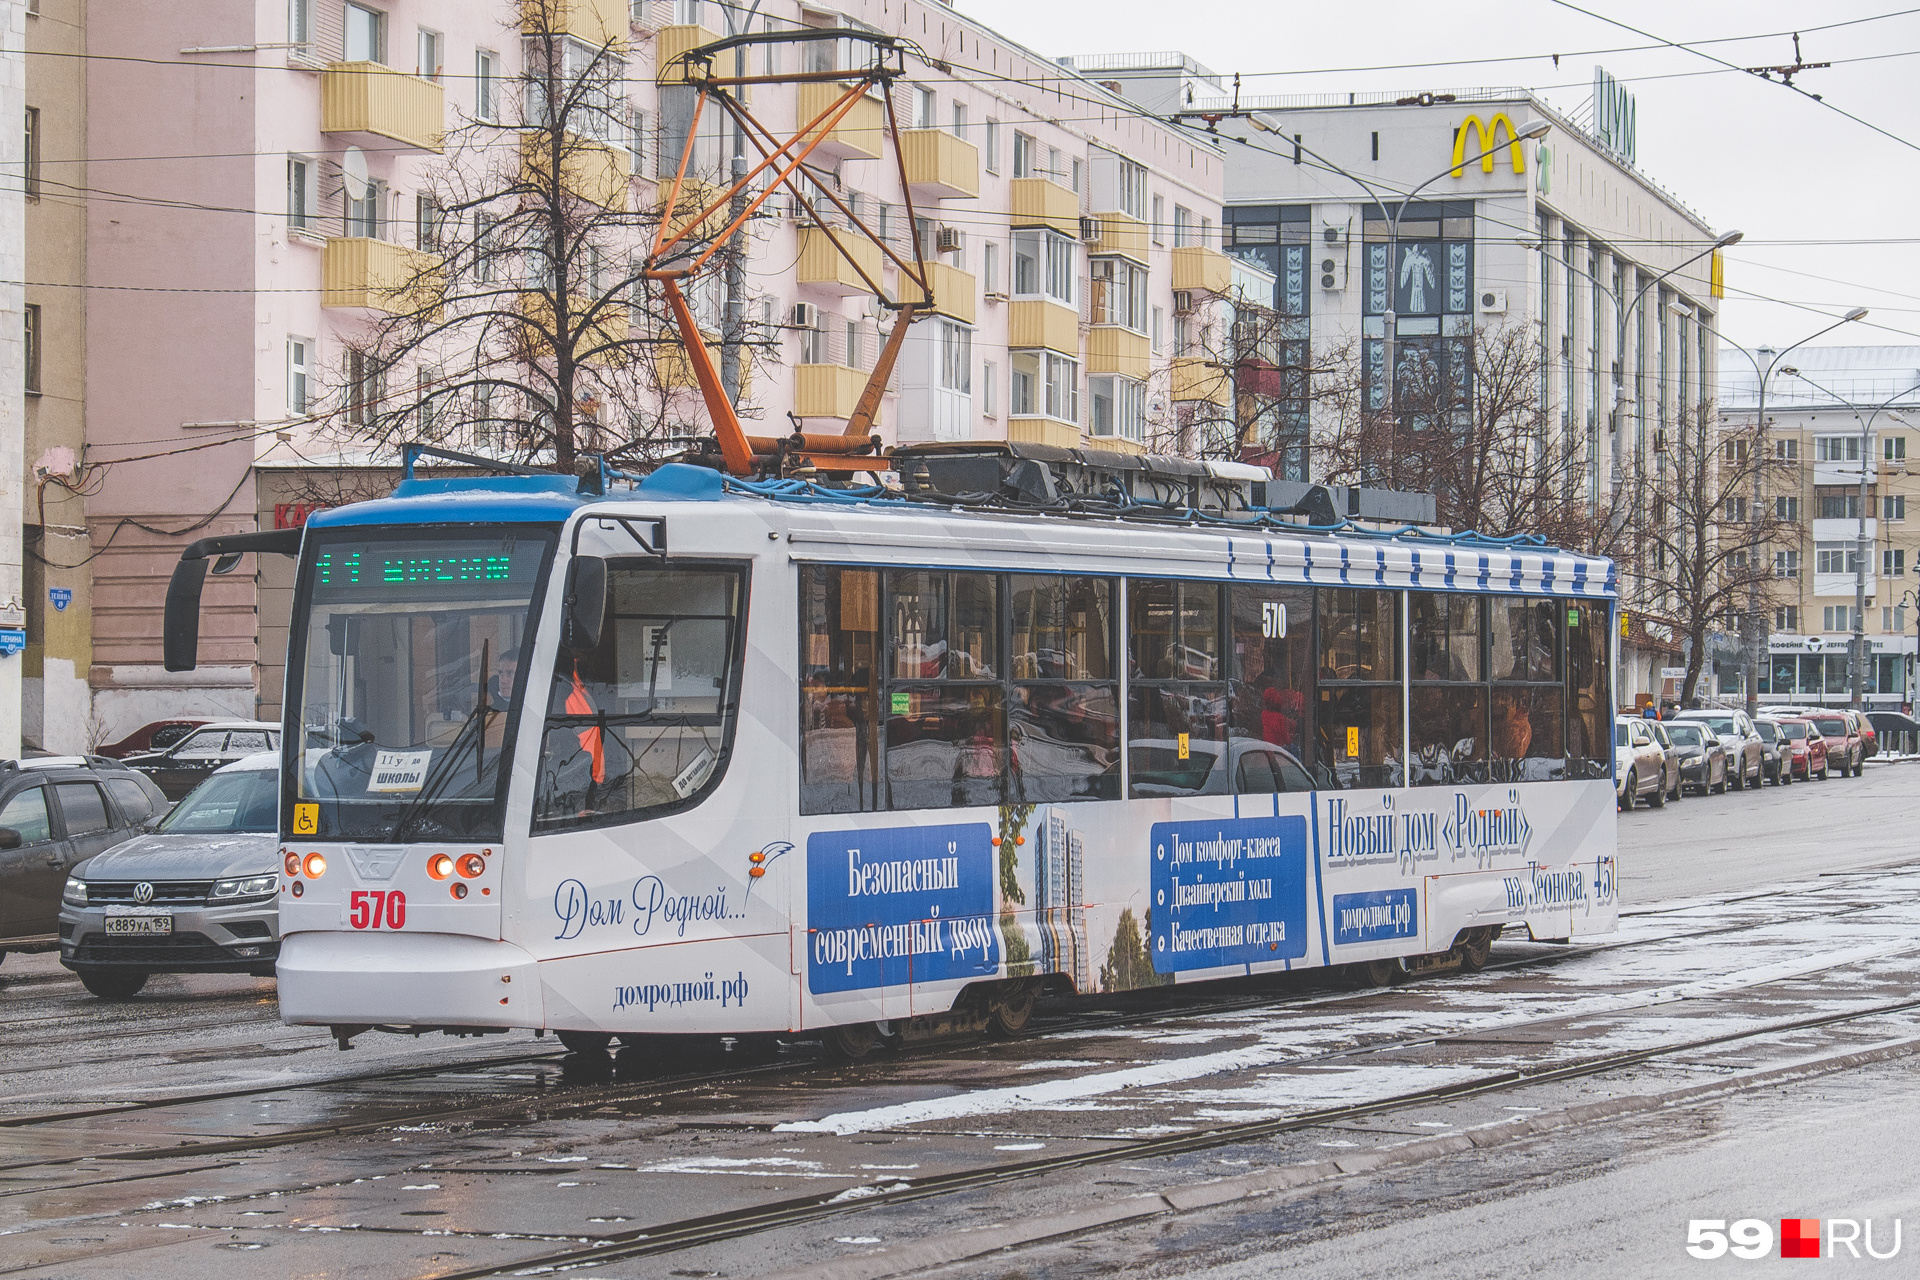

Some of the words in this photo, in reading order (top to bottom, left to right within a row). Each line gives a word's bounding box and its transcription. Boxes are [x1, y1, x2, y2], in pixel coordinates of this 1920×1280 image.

[1594, 65, 1635, 167] ЦУМ
[1262, 602, 1287, 639] 570
[376, 772, 420, 784] ШКОЛЫ
[678, 778, 688, 791] ДО
[1328, 794, 1394, 858] Новый
[1400, 812, 1436, 864] дом
[1442, 788, 1531, 860] «Родной»
[847, 841, 959, 897] Безопасный
[1170, 833, 1194, 872] Дом
[1196, 831, 1281, 871] комфорт-класса
[350, 890, 406, 929] 570
[554, 878, 626, 940] Дом
[1170, 870, 1246, 915] Дизайнерский
[1248, 878, 1272, 900] холл
[1503, 876, 1525, 908] на
[152, 918, 169, 928] 159
[1171, 922, 1244, 953] Качественная
[1246, 920, 1286, 950] отделка
[1340, 895, 1411, 937] домродной.рф
[815, 905, 945, 976] современный
[948, 917, 992, 962] двор
[613, 971, 749, 1013] домродной.рф
